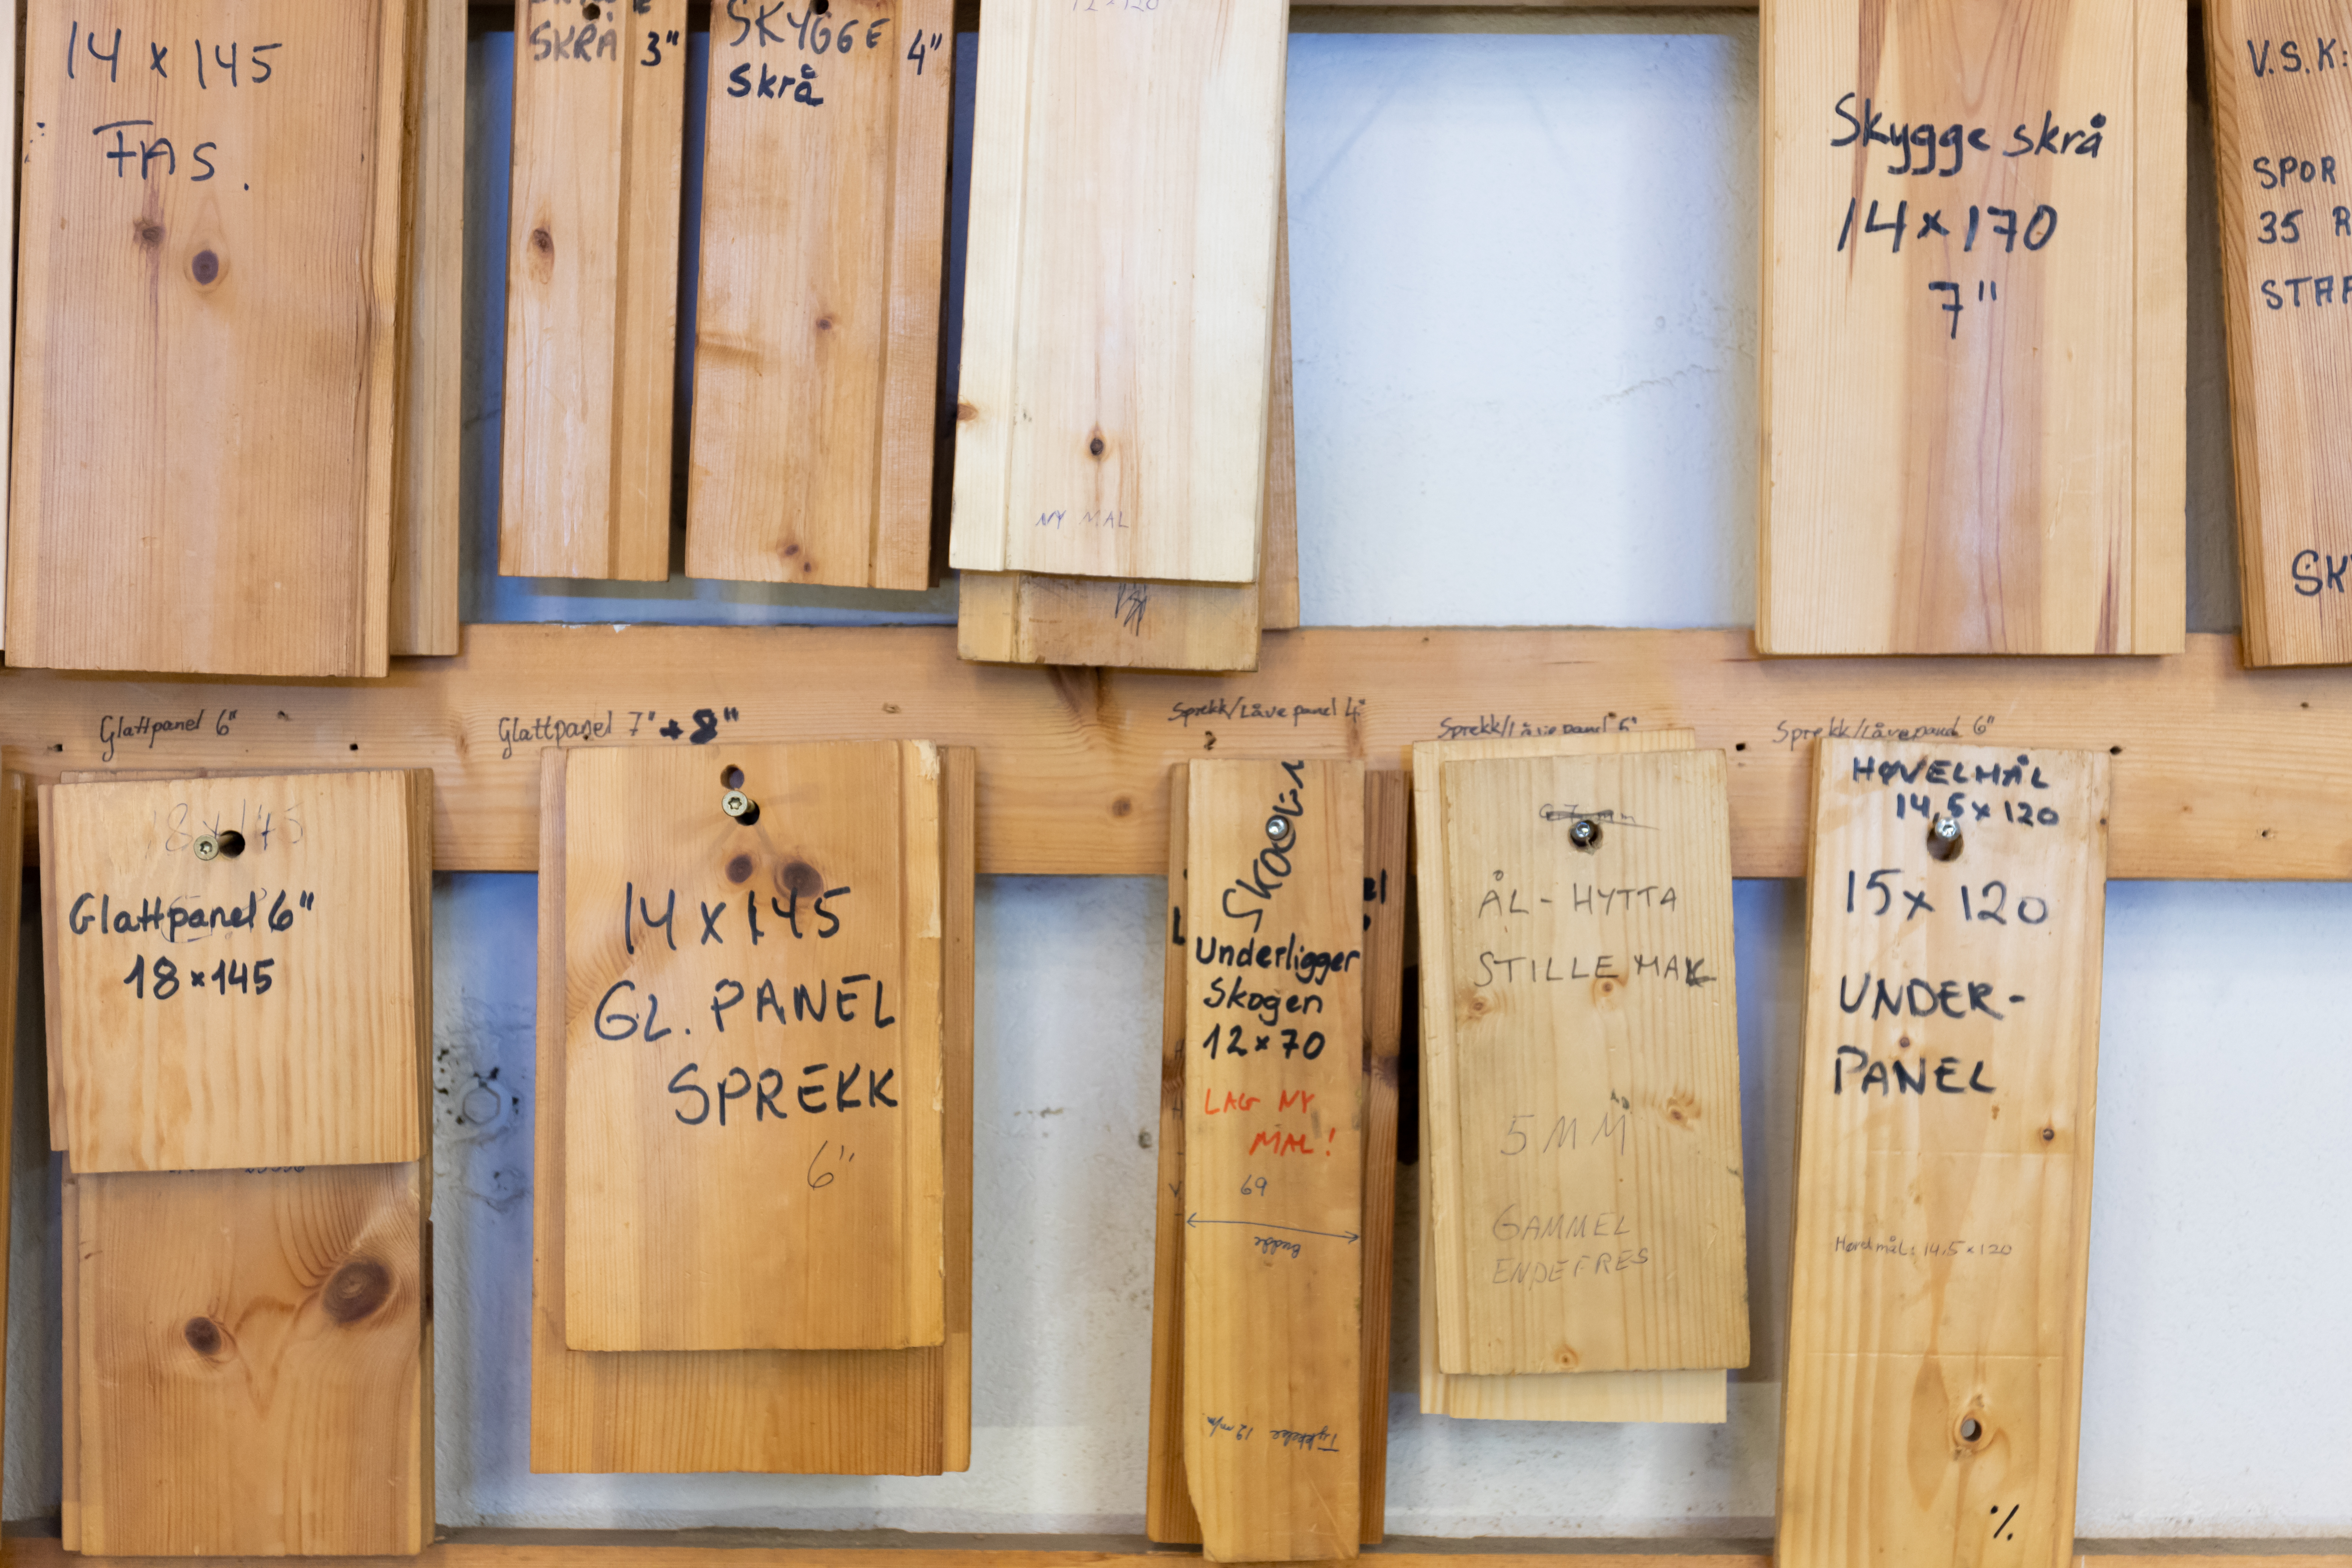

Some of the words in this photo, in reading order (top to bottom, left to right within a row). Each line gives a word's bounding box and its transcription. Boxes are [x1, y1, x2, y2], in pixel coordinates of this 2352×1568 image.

[727, 0, 890, 55] SKYGGE
[727, 62, 824, 107] Skrå
[1830, 92, 1991, 177] Skygge
[2253, 155, 2336, 190] SPOR
[2258, 209, 2304, 244] 35
[1035, 510, 1067, 529] NY
[2292, 549, 2352, 597] SK
[100, 709, 205, 762] Glattpanel
[498, 710, 612, 759] Glattpanel
[69, 890, 256, 943] Glattpanel
[1196, 933, 1360, 985] Underligger
[1474, 951, 1619, 987] STILLE
[710, 973, 896, 1033] PANEL
[1204, 975, 1323, 1026] Skogen
[668, 1062, 898, 1127] SPREKK
[1834, 1045, 1997, 1096] PANEL
[1205, 1088, 1261, 1115] LAG
[1278, 1090, 1315, 1113] NY
[1493, 1204, 1631, 1242] GAMMEL
